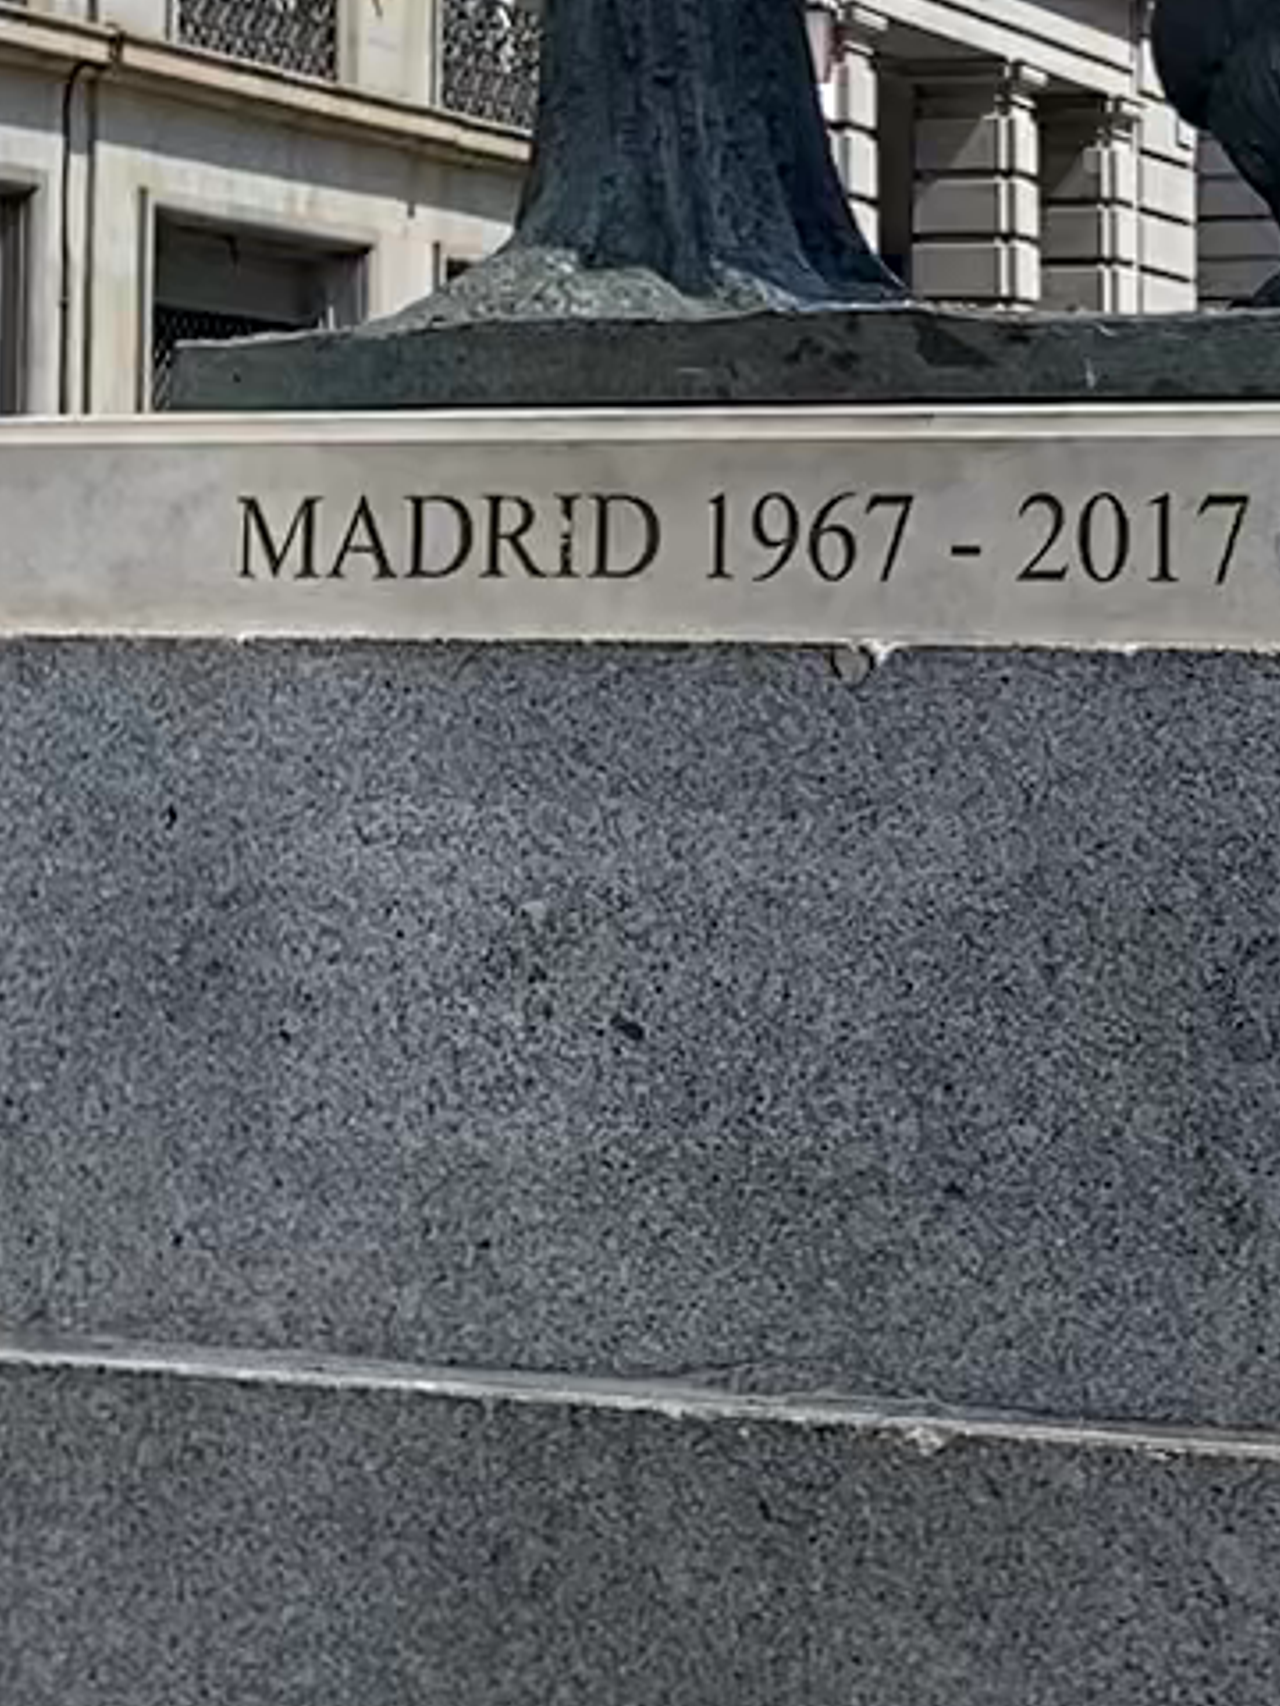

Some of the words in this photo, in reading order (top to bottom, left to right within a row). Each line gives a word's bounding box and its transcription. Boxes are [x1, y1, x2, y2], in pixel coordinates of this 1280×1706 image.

[237, 492, 661, 580] MADRID
[706, 492, 914, 584] 1967
[1016, 492, 1251, 586] 2017
